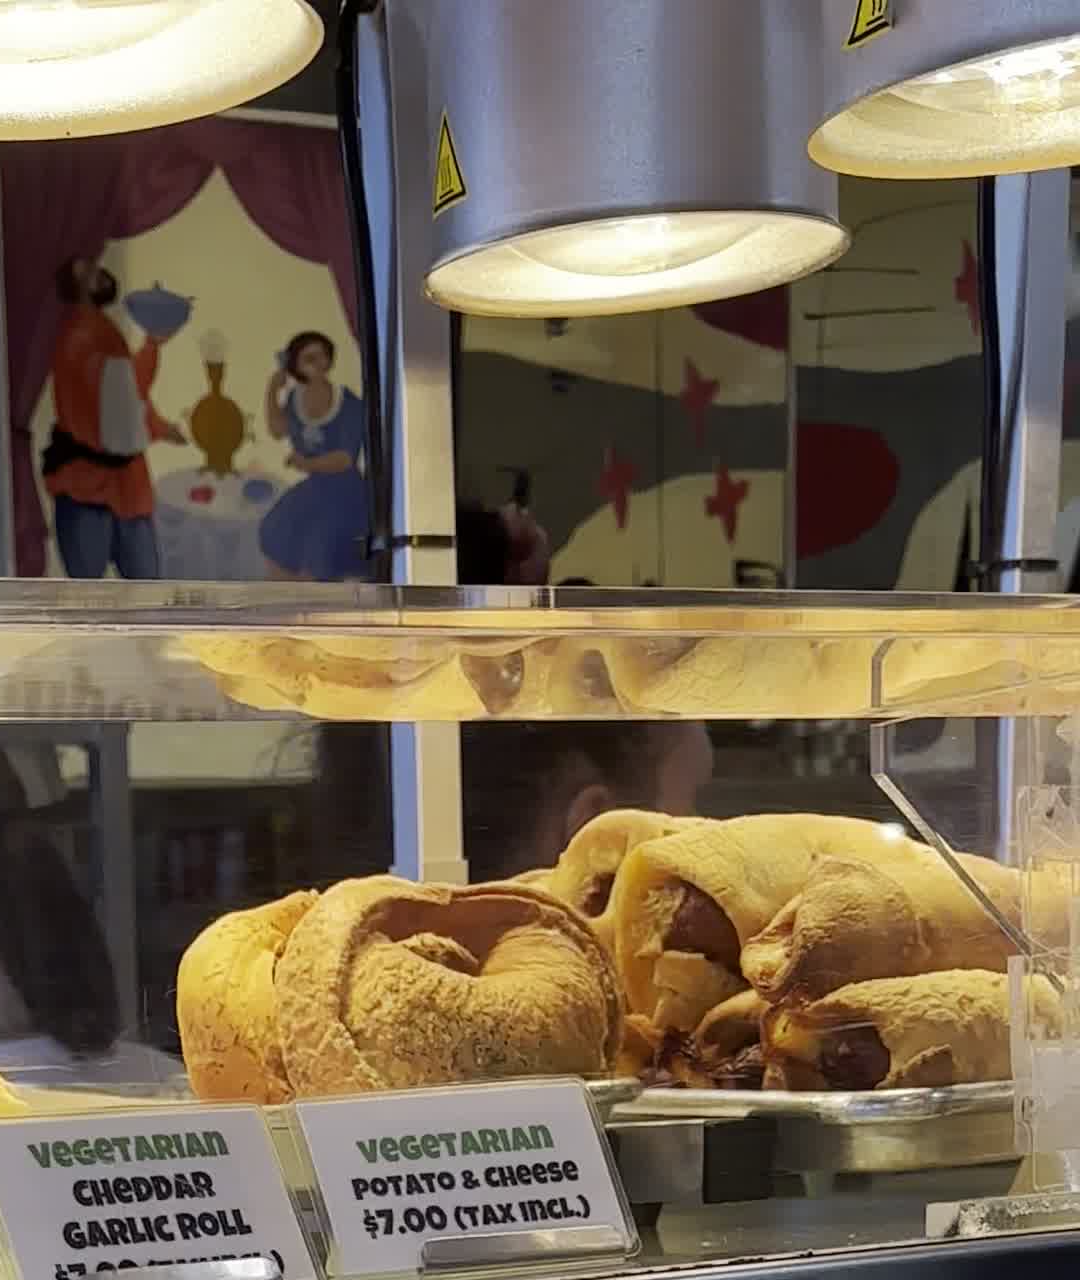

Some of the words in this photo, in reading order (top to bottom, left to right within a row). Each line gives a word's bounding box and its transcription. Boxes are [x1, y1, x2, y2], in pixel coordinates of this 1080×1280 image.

[351, 1171, 456, 1201] POTATO
[461, 1169, 481, 1190] &
[62, 1215, 175, 1250] GARLIC
[176, 1208, 253, 1242] ROLL
[363, 1204, 448, 1239] $7.00
[453, 1201, 516, 1231] (TAX
